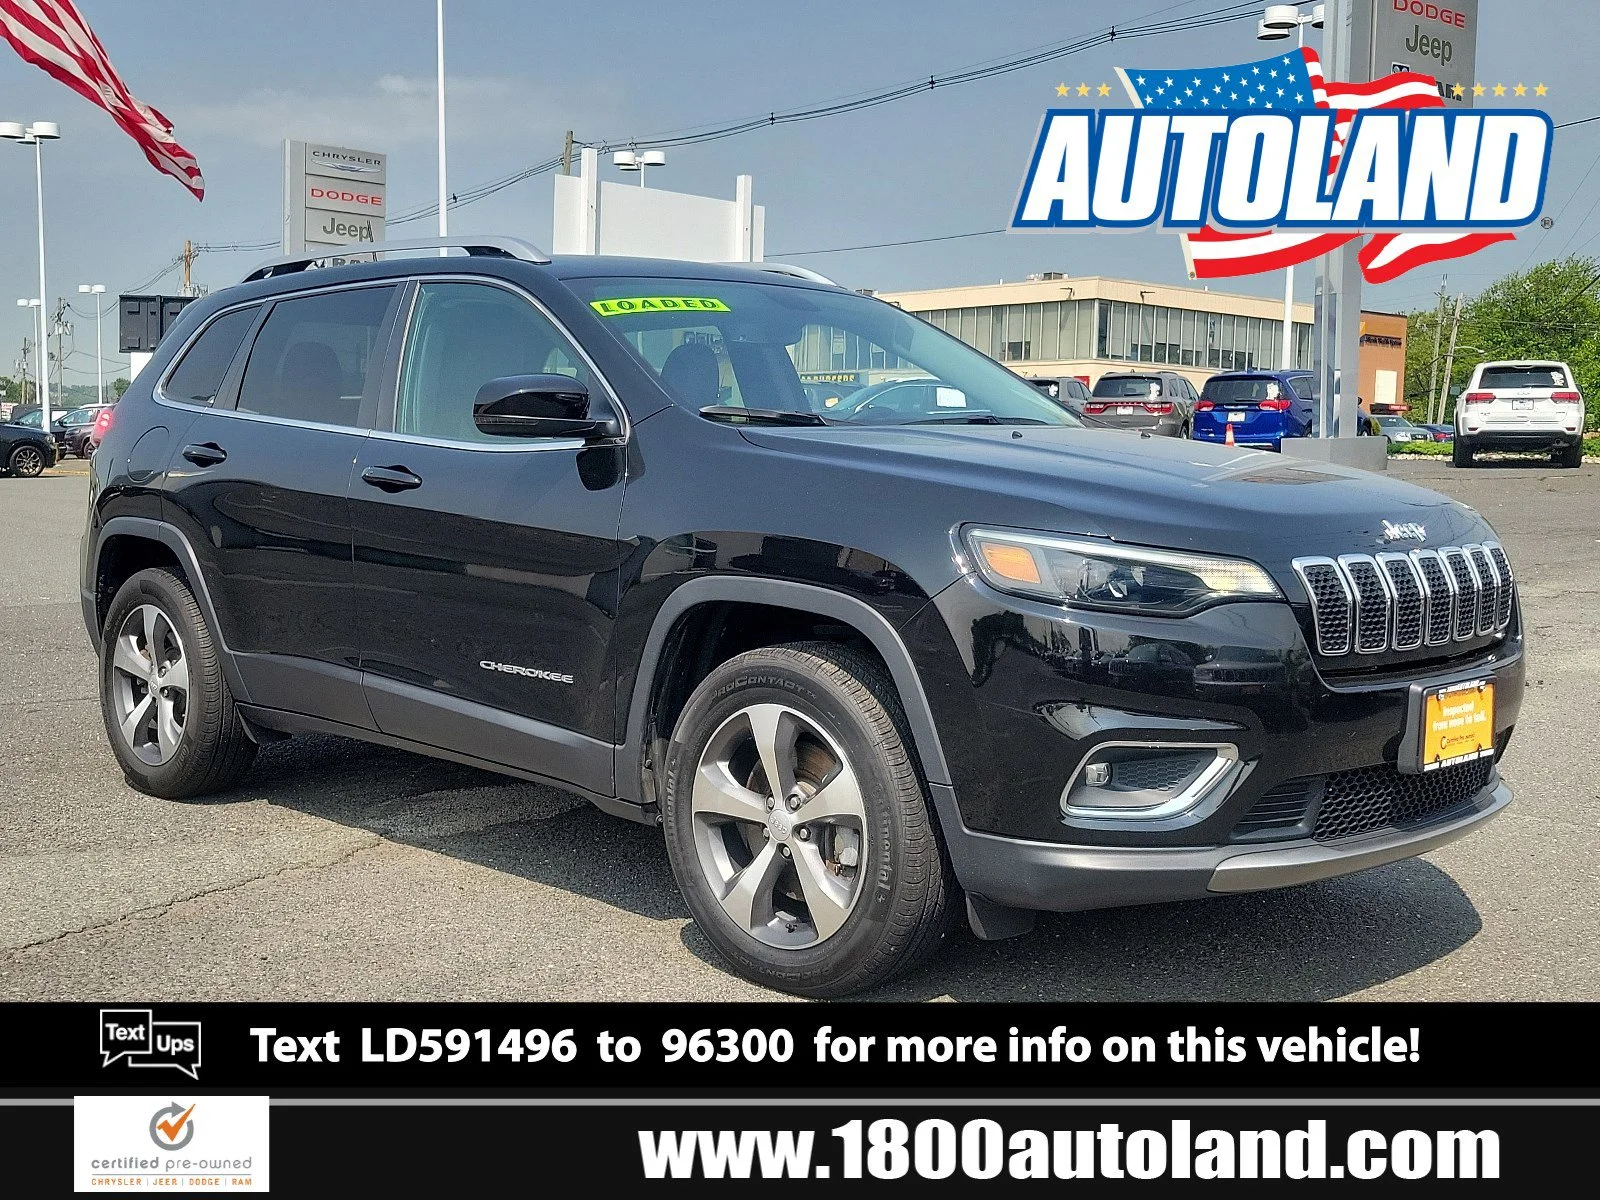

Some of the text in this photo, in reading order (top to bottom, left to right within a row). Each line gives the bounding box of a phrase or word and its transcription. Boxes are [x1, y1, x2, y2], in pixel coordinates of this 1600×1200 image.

[1393, 0, 1466, 28] DODGE
[1405, 24, 1453, 66] Jeep
[312, 150, 381, 166] CHRYSLER
[310, 187, 382, 206] DODGE
[322, 217, 370, 242] Jeep
[600, 299, 717, 313] LOADED
[1380, 519, 1427, 543] Jeep
[479, 660, 574, 684] CHEROKEE
